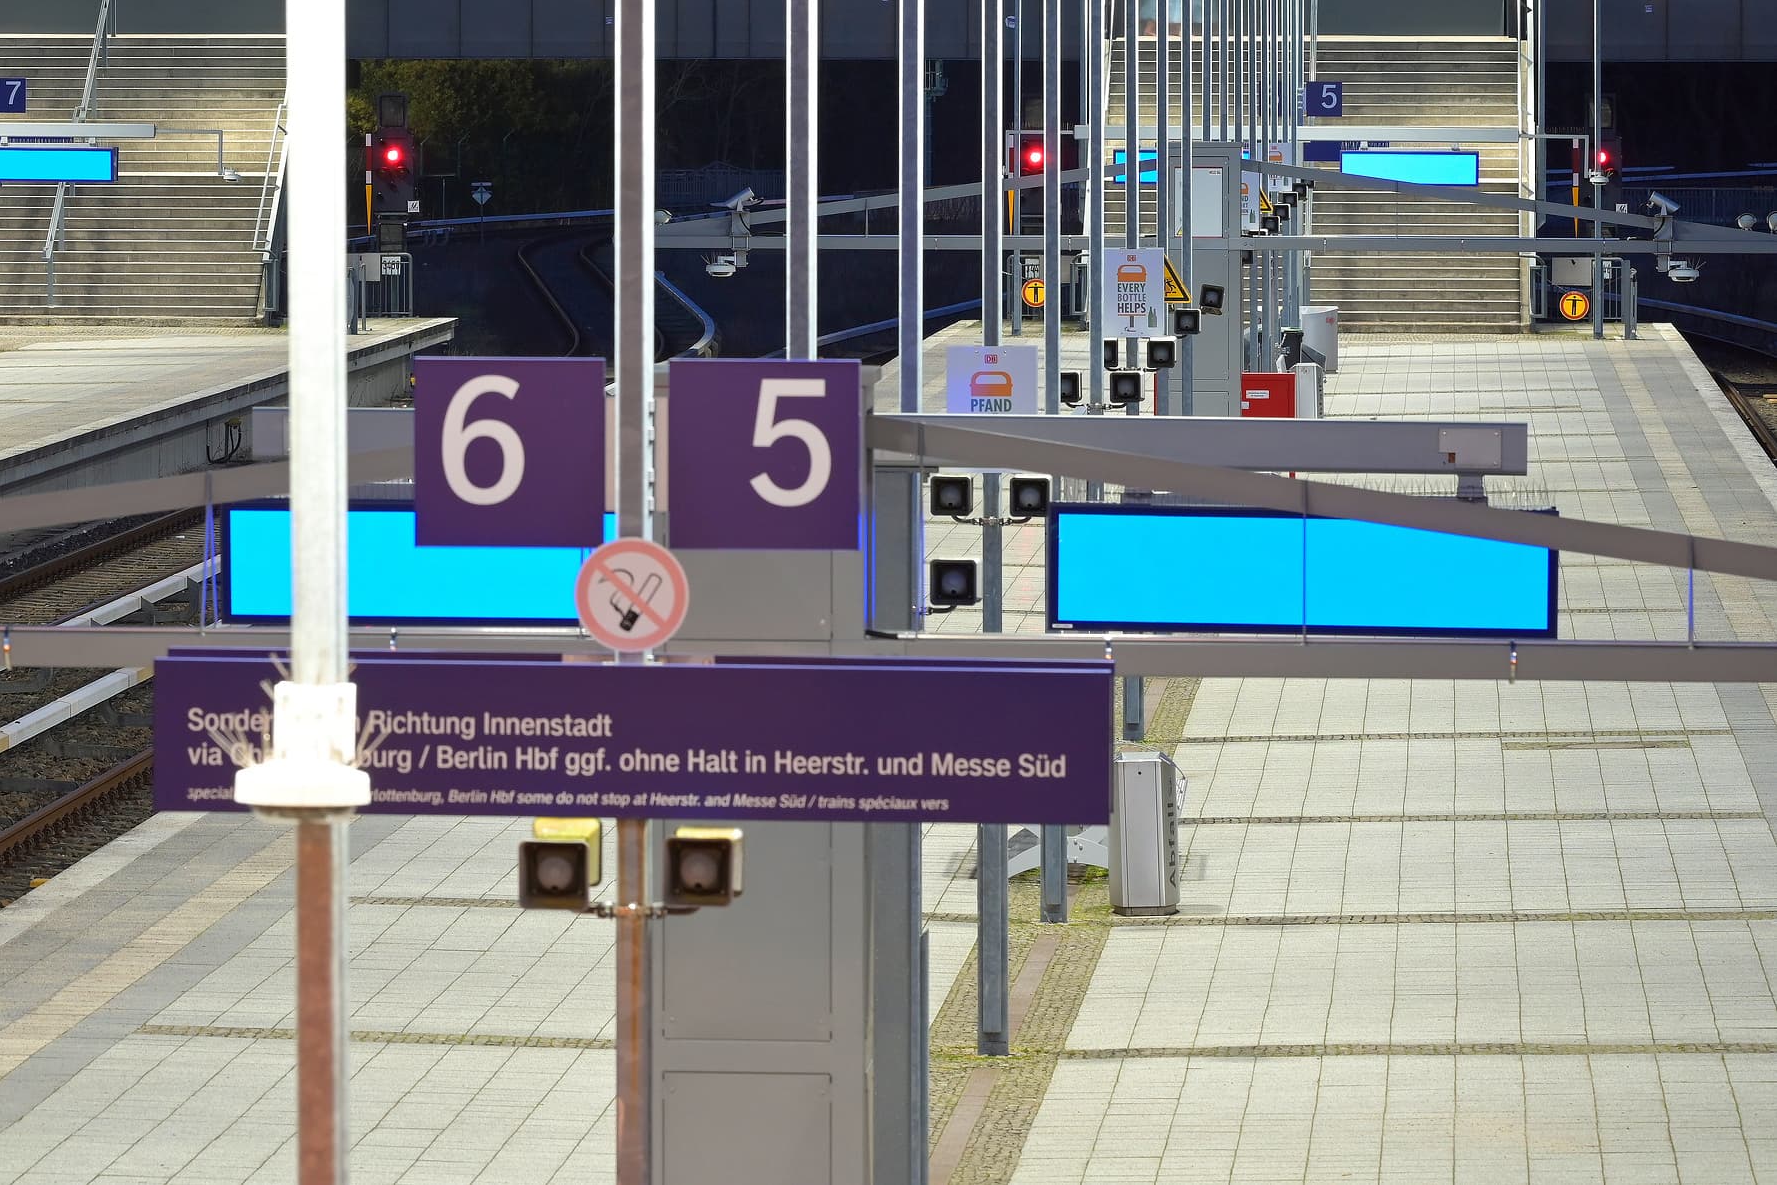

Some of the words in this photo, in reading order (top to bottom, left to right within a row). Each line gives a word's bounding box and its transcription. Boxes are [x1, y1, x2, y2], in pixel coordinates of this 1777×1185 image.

[5, 80, 22, 105] 7
[1321, 84, 1338, 109] 5
[1118, 283, 1146, 292] EVERY
[1118, 294, 1146, 302] BOTTLE
[1118, 303, 1146, 313] HELPS
[971, 398, 1012, 412] PFAND
[440, 374, 525, 505] 6
[749, 378, 832, 507] 5
[187, 706, 274, 732] Sonder
[369, 709, 476, 740] Richtung
[483, 711, 613, 737] Innenstadt
[187, 741, 223, 766] via
[436, 745, 508, 770] Berlin
[515, 746, 560, 771] Hbf
[565, 747, 611, 776] ggf.
[619, 748, 680, 773] ohne
[687, 749, 738, 773] Halt
[745, 750, 767, 774] in
[774, 750, 869, 775] Heerstr.
[877, 752, 923, 776] und
[931, 752, 1011, 777] Messe
[1018, 753, 1067, 778] Süd
[370, 788, 444, 805] lottenburg,
[448, 788, 487, 804] Berlin
[490, 789, 515, 804] Hbf
[517, 794, 554, 805] some
[555, 791, 574, 805] do
[576, 792, 599, 806] not
[601, 792, 631, 808] stop
[632, 793, 648, 806] at
[650, 792, 701, 807] Heerstr.
[704, 793, 731, 807] and
[733, 794, 777, 808] Messe
[779, 793, 806, 809] Süd
[817, 795, 855, 809] trains
[858, 794, 917, 811] spéciaux
[921, 798, 949, 810] vers
[1167, 803, 1177, 888] Abfall
